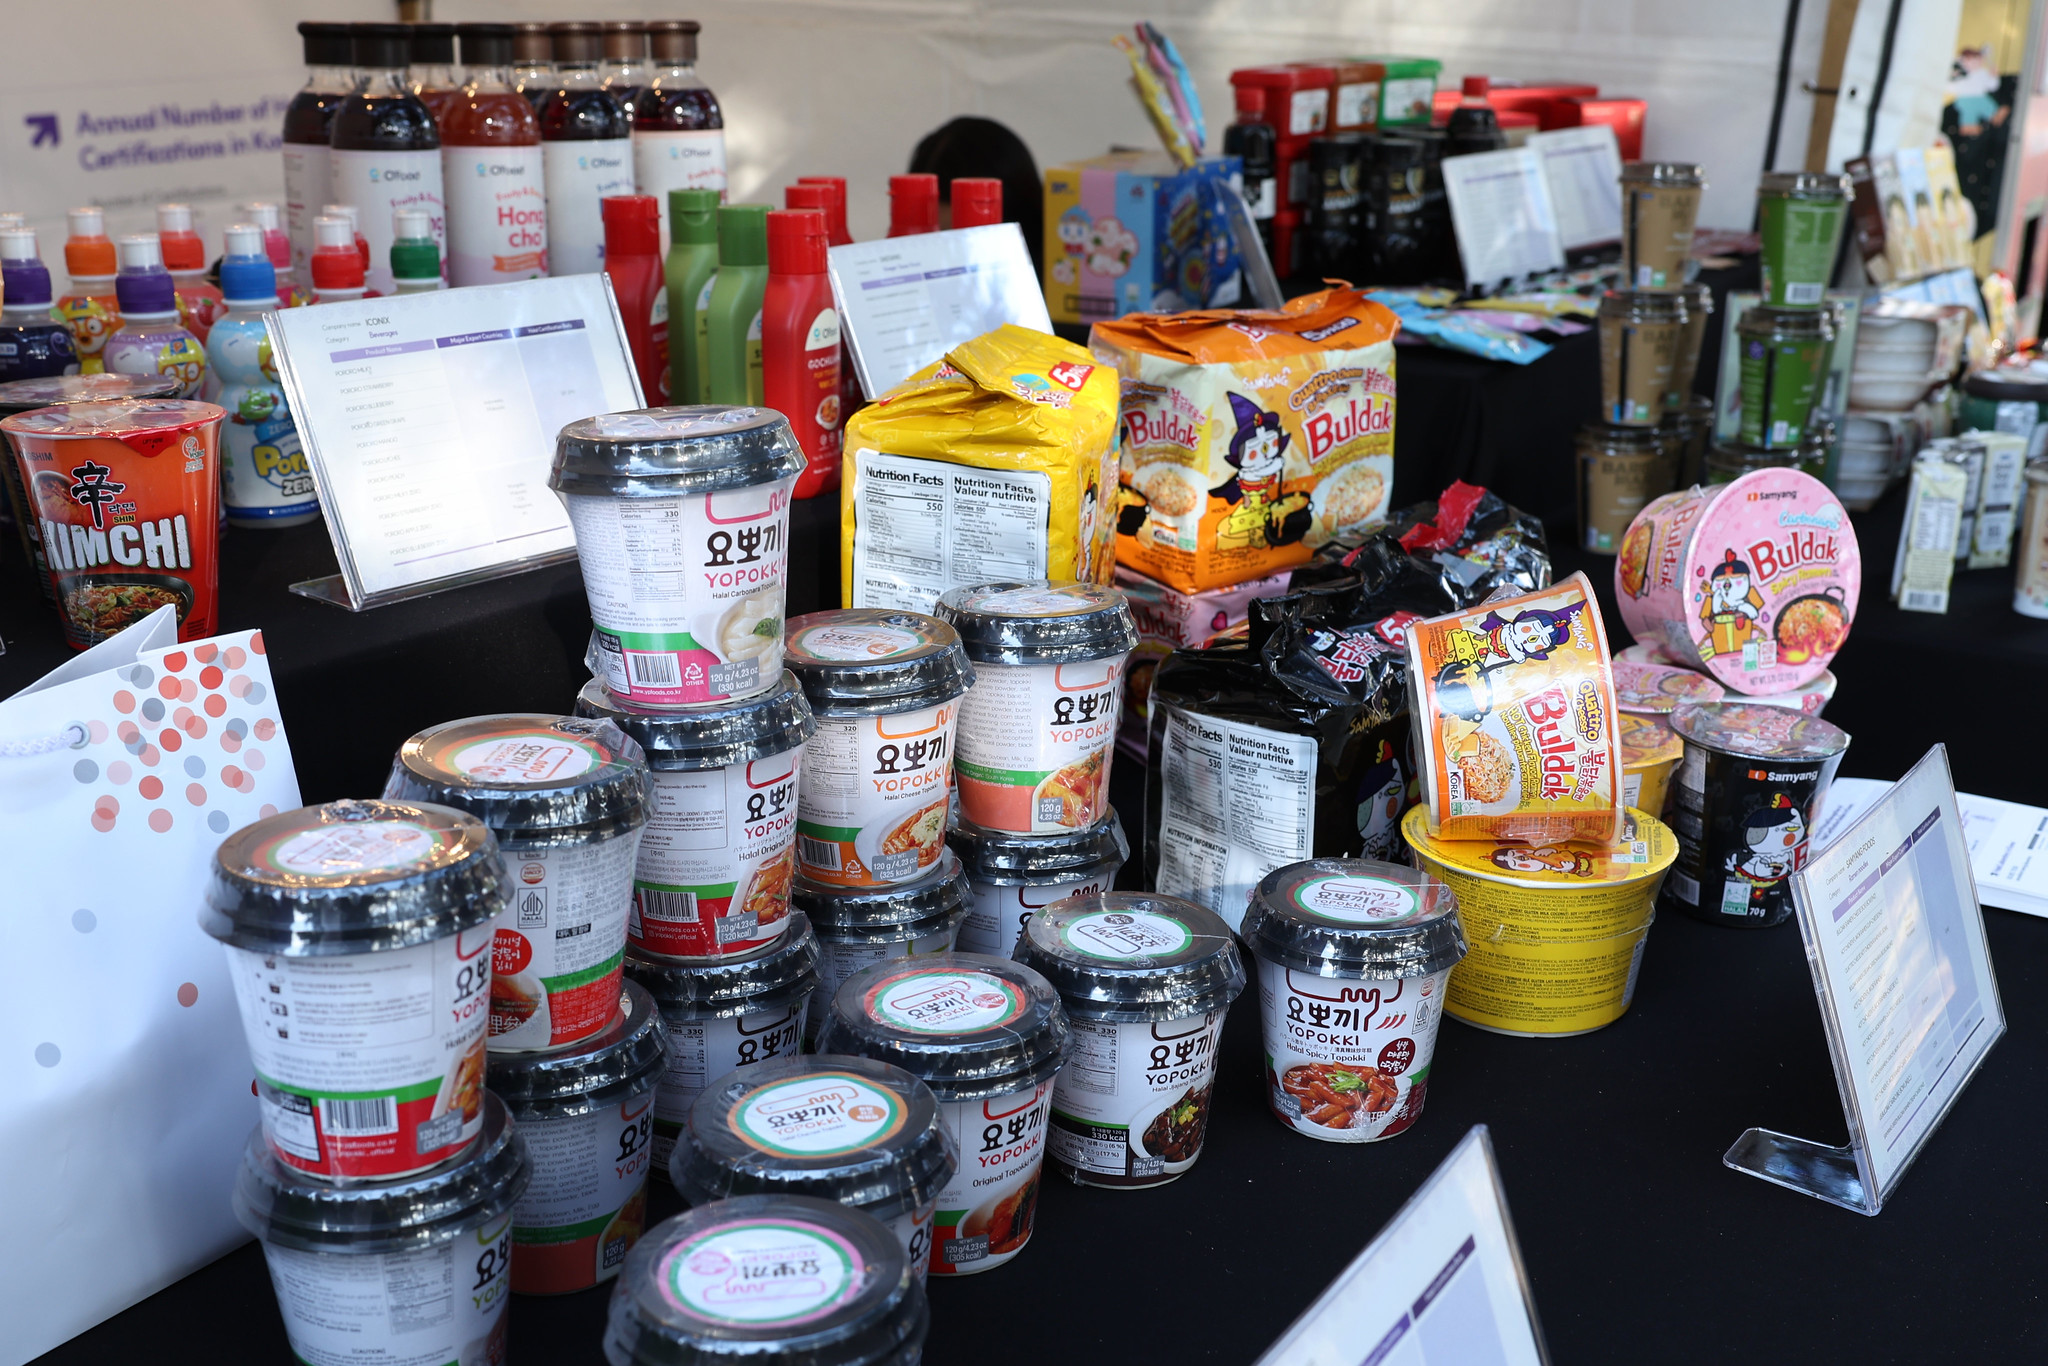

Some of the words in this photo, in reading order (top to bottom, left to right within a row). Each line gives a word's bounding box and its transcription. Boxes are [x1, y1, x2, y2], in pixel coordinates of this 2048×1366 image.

[508, 228, 542, 248] cho
[365, 316, 391, 327] ICONIX
[368, 329, 399, 340] Beverages
[450, 336, 465, 346] Major
[465, 333, 482, 344] Export
[482, 331, 504, 341] Countries
[1059, 368, 1083, 390] 5
[1291, 369, 1337, 408] Quattro
[1123, 409, 1199, 450] Buldak
[1305, 397, 1392, 459] Buldak
[866, 465, 910, 484] Nutrition
[913, 472, 944, 487] Facts
[954, 476, 1001, 491] Nutrition
[1004, 482, 1034, 495] Facts
[71, 460, 125, 530] 辛
[954, 486, 988, 498] Valeur
[991, 491, 1037, 504] nutritive
[1759, 490, 1798, 502] Samyang
[107, 502, 136, 515] 라면
[621, 512, 642, 520] Calories
[665, 510, 679, 518] 330
[926, 502, 943, 512] 550
[953, 503, 974, 513] Calories
[113, 515, 135, 524] SHIN
[40, 514, 191, 571] KIMCHI
[704, 518, 781, 567] 요뽀끼
[1659, 504, 1698, 593] Buldak
[1747, 530, 1839, 583] Buldak
[704, 560, 781, 589] YOPOKKI
[712, 591, 730, 600] Halal
[730, 584, 761, 598] Carbonara
[865, 579, 897, 590] NUTRITION
[1770, 575, 1798, 596] Spicy
[1380, 617, 1404, 645] 5
[1569, 609, 1594, 651] SAMYANG
[686, 679, 704, 687] OTHER
[711, 671, 723, 682] 120
[750, 666, 759, 675] oz
[632, 688, 681, 697] www.ypfoods.co.kr
[718, 681, 734, 694] (330
[735, 677, 753, 691] kcal)
[991, 705, 1014, 714] powder,
[1050, 686, 1116, 726] 요뽀끼
[1579, 679, 1604, 742] Quattro
[1017, 727, 1034, 735] dried
[1198, 724, 1223, 743] Facts
[1229, 733, 1266, 750] Nutrition
[1268, 742, 1290, 756] Facts
[1499, 710, 1518, 740] Nouilles
[1511, 739, 1528, 773] piquantes
[1508, 705, 1526, 725] HOT
[1528, 753, 1538, 778] Flavor
[1524, 684, 1576, 801] Buldak
[873, 731, 948, 775] 요뽀끼
[1229, 744, 1255, 758] Valeur
[1256, 751, 1294, 766] nutritive
[1208, 758, 1222, 770] 530
[1228, 762, 1247, 773] Calories
[1248, 766, 1258, 775] 530
[872, 767, 945, 793] YOPOKKI
[1449, 770, 1462, 800] KOREA
[1573, 749, 1605, 802] 불닭볶음면
[1767, 770, 1818, 783] Samyang
[900, 791, 921, 800] Cheese
[1039, 812, 1054, 821] 4.23
[1040, 803, 1054, 813] 120
[1055, 805, 1061, 815] g
[739, 849, 760, 862] Halal
[761, 839, 786, 855] Original
[1167, 827, 1193, 842] NUTRITION
[1194, 836, 1227, 855] INFORMATION
[582, 849, 596, 859] 120
[1845, 848, 1863, 869] SAMYANG
[1862, 836, 1876, 852] FOODS
[873, 862, 885, 871] 120
[909, 856, 918, 864] oz
[879, 869, 895, 880] (325
[1446, 869, 1481, 884] INGREDIENTS
[1313, 897, 1366, 909] YOPOKKI
[1315, 891, 1370, 904] 요뽀끼
[1723, 904, 1747, 913] HALAL
[496, 960, 513, 971] 김치
[907, 997, 964, 1020] 요뽀끼
[920, 1005, 972, 1023] YOPOKKI
[1286, 996, 1360, 1032] 요뽀끼
[1100, 1027, 1118, 1035] 330
[1285, 1021, 1359, 1046] YOPOKKI
[736, 1019, 799, 1067] 요뽀끼
[1147, 1028, 1214, 1071] 요뽀끼
[1286, 1041, 1305, 1055] Halal
[1305, 1049, 1329, 1062] Spicy
[1330, 1053, 1366, 1062] Topokki
[1145, 1056, 1210, 1086] YOPOKKI
[767, 1104, 837, 1129] 요뽀끼
[773, 1116, 843, 1135] YOPOKKI
[979, 1103, 1044, 1153] 요뽀끼
[1091, 1131, 1108, 1141] 330
[1108, 1133, 1127, 1142] kcal
[978, 1130, 1042, 1168] YOPOKKI
[972, 1172, 1004, 1188] Original
[1004, 1160, 1029, 1181] Topokki
[605, 1243, 619, 1258] 120
[945, 1243, 957, 1254] 120
[979, 1240, 988, 1249] oz
[949, 1252, 964, 1264] (305
[964, 1248, 982, 1261] kcal)
